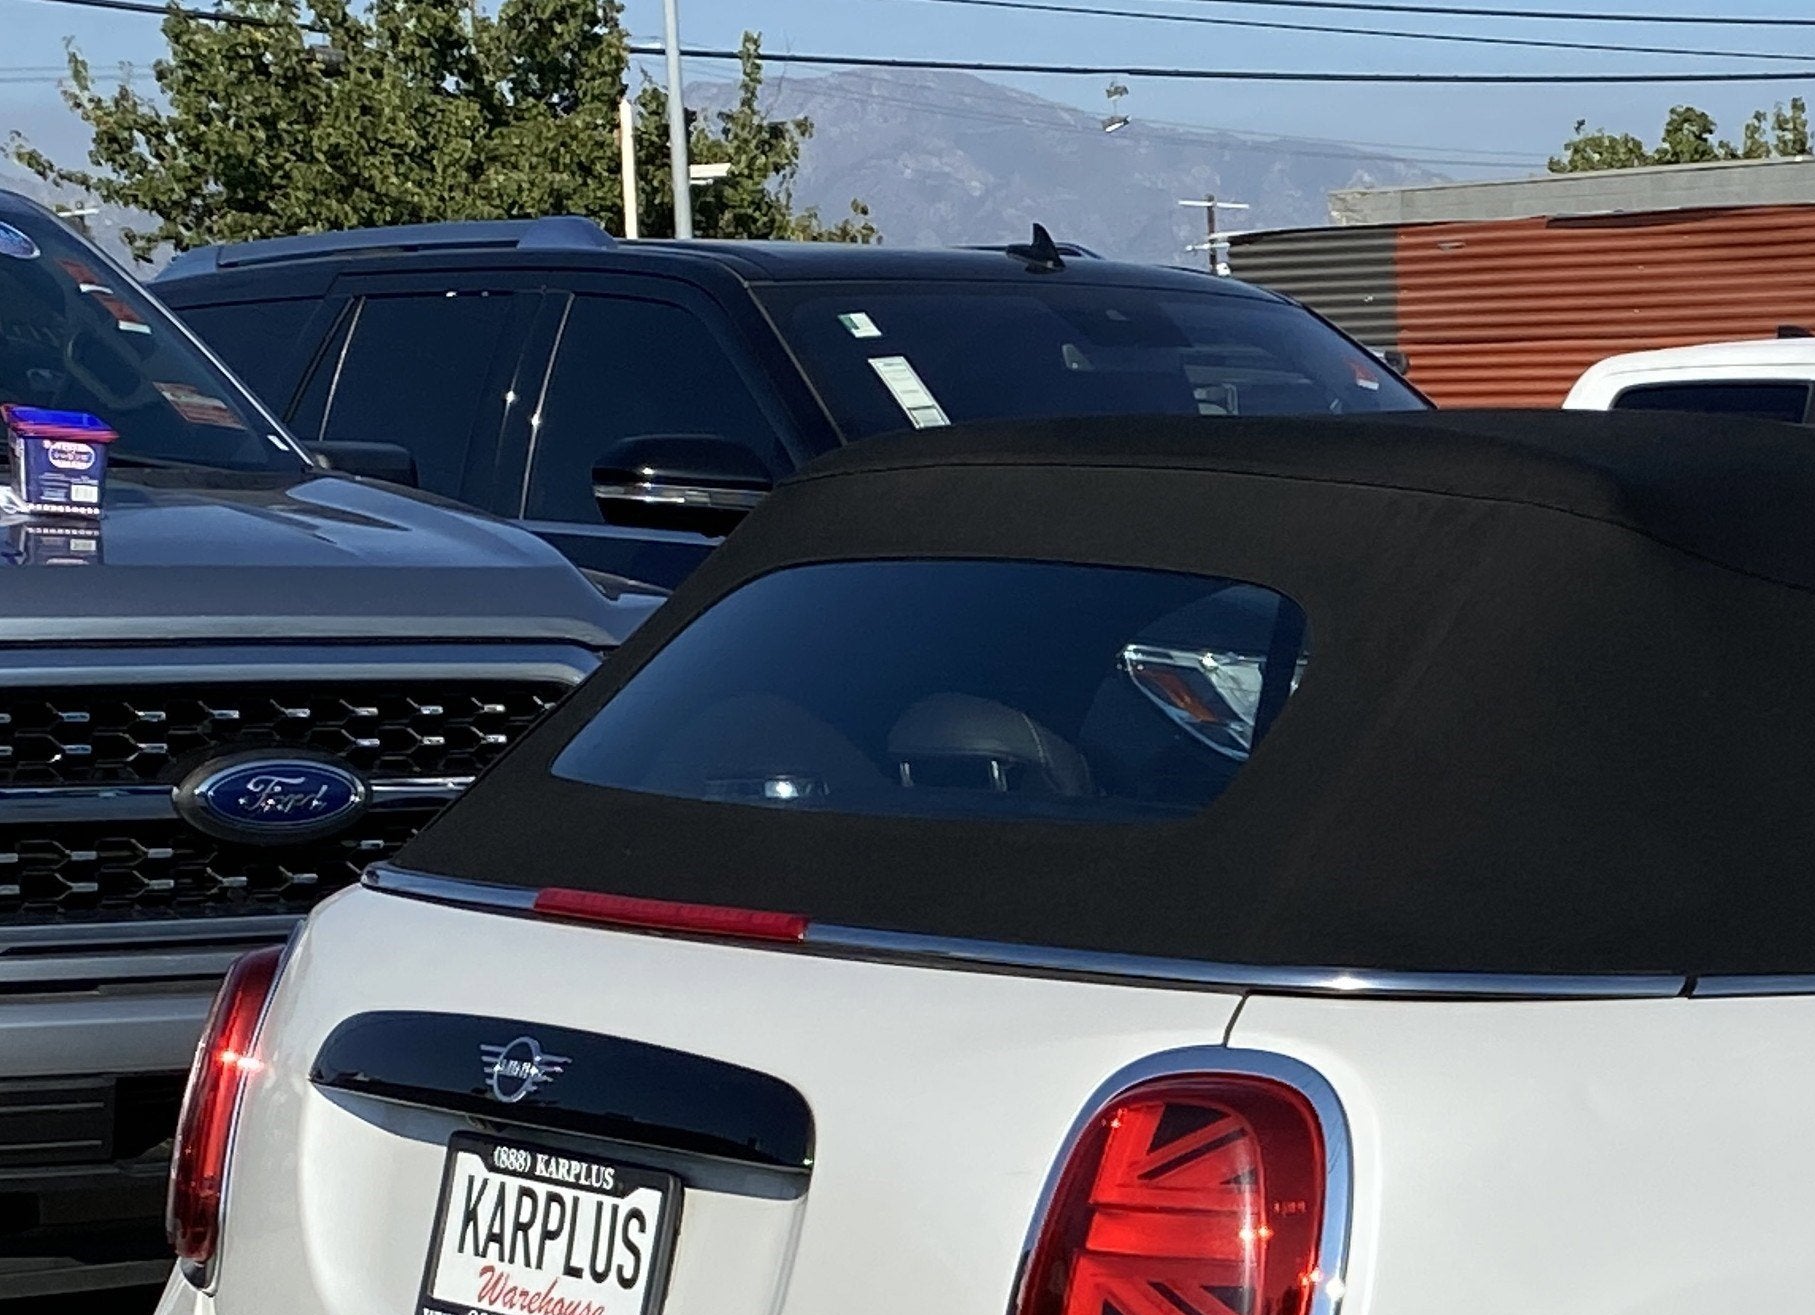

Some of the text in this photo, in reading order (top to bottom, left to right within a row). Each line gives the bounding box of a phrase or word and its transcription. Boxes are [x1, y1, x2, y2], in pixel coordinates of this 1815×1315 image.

[238, 775, 328, 813] Ford
[493, 1146, 616, 1190] (888) KARPLUS
[457, 1174, 648, 1290] KARPLUS
